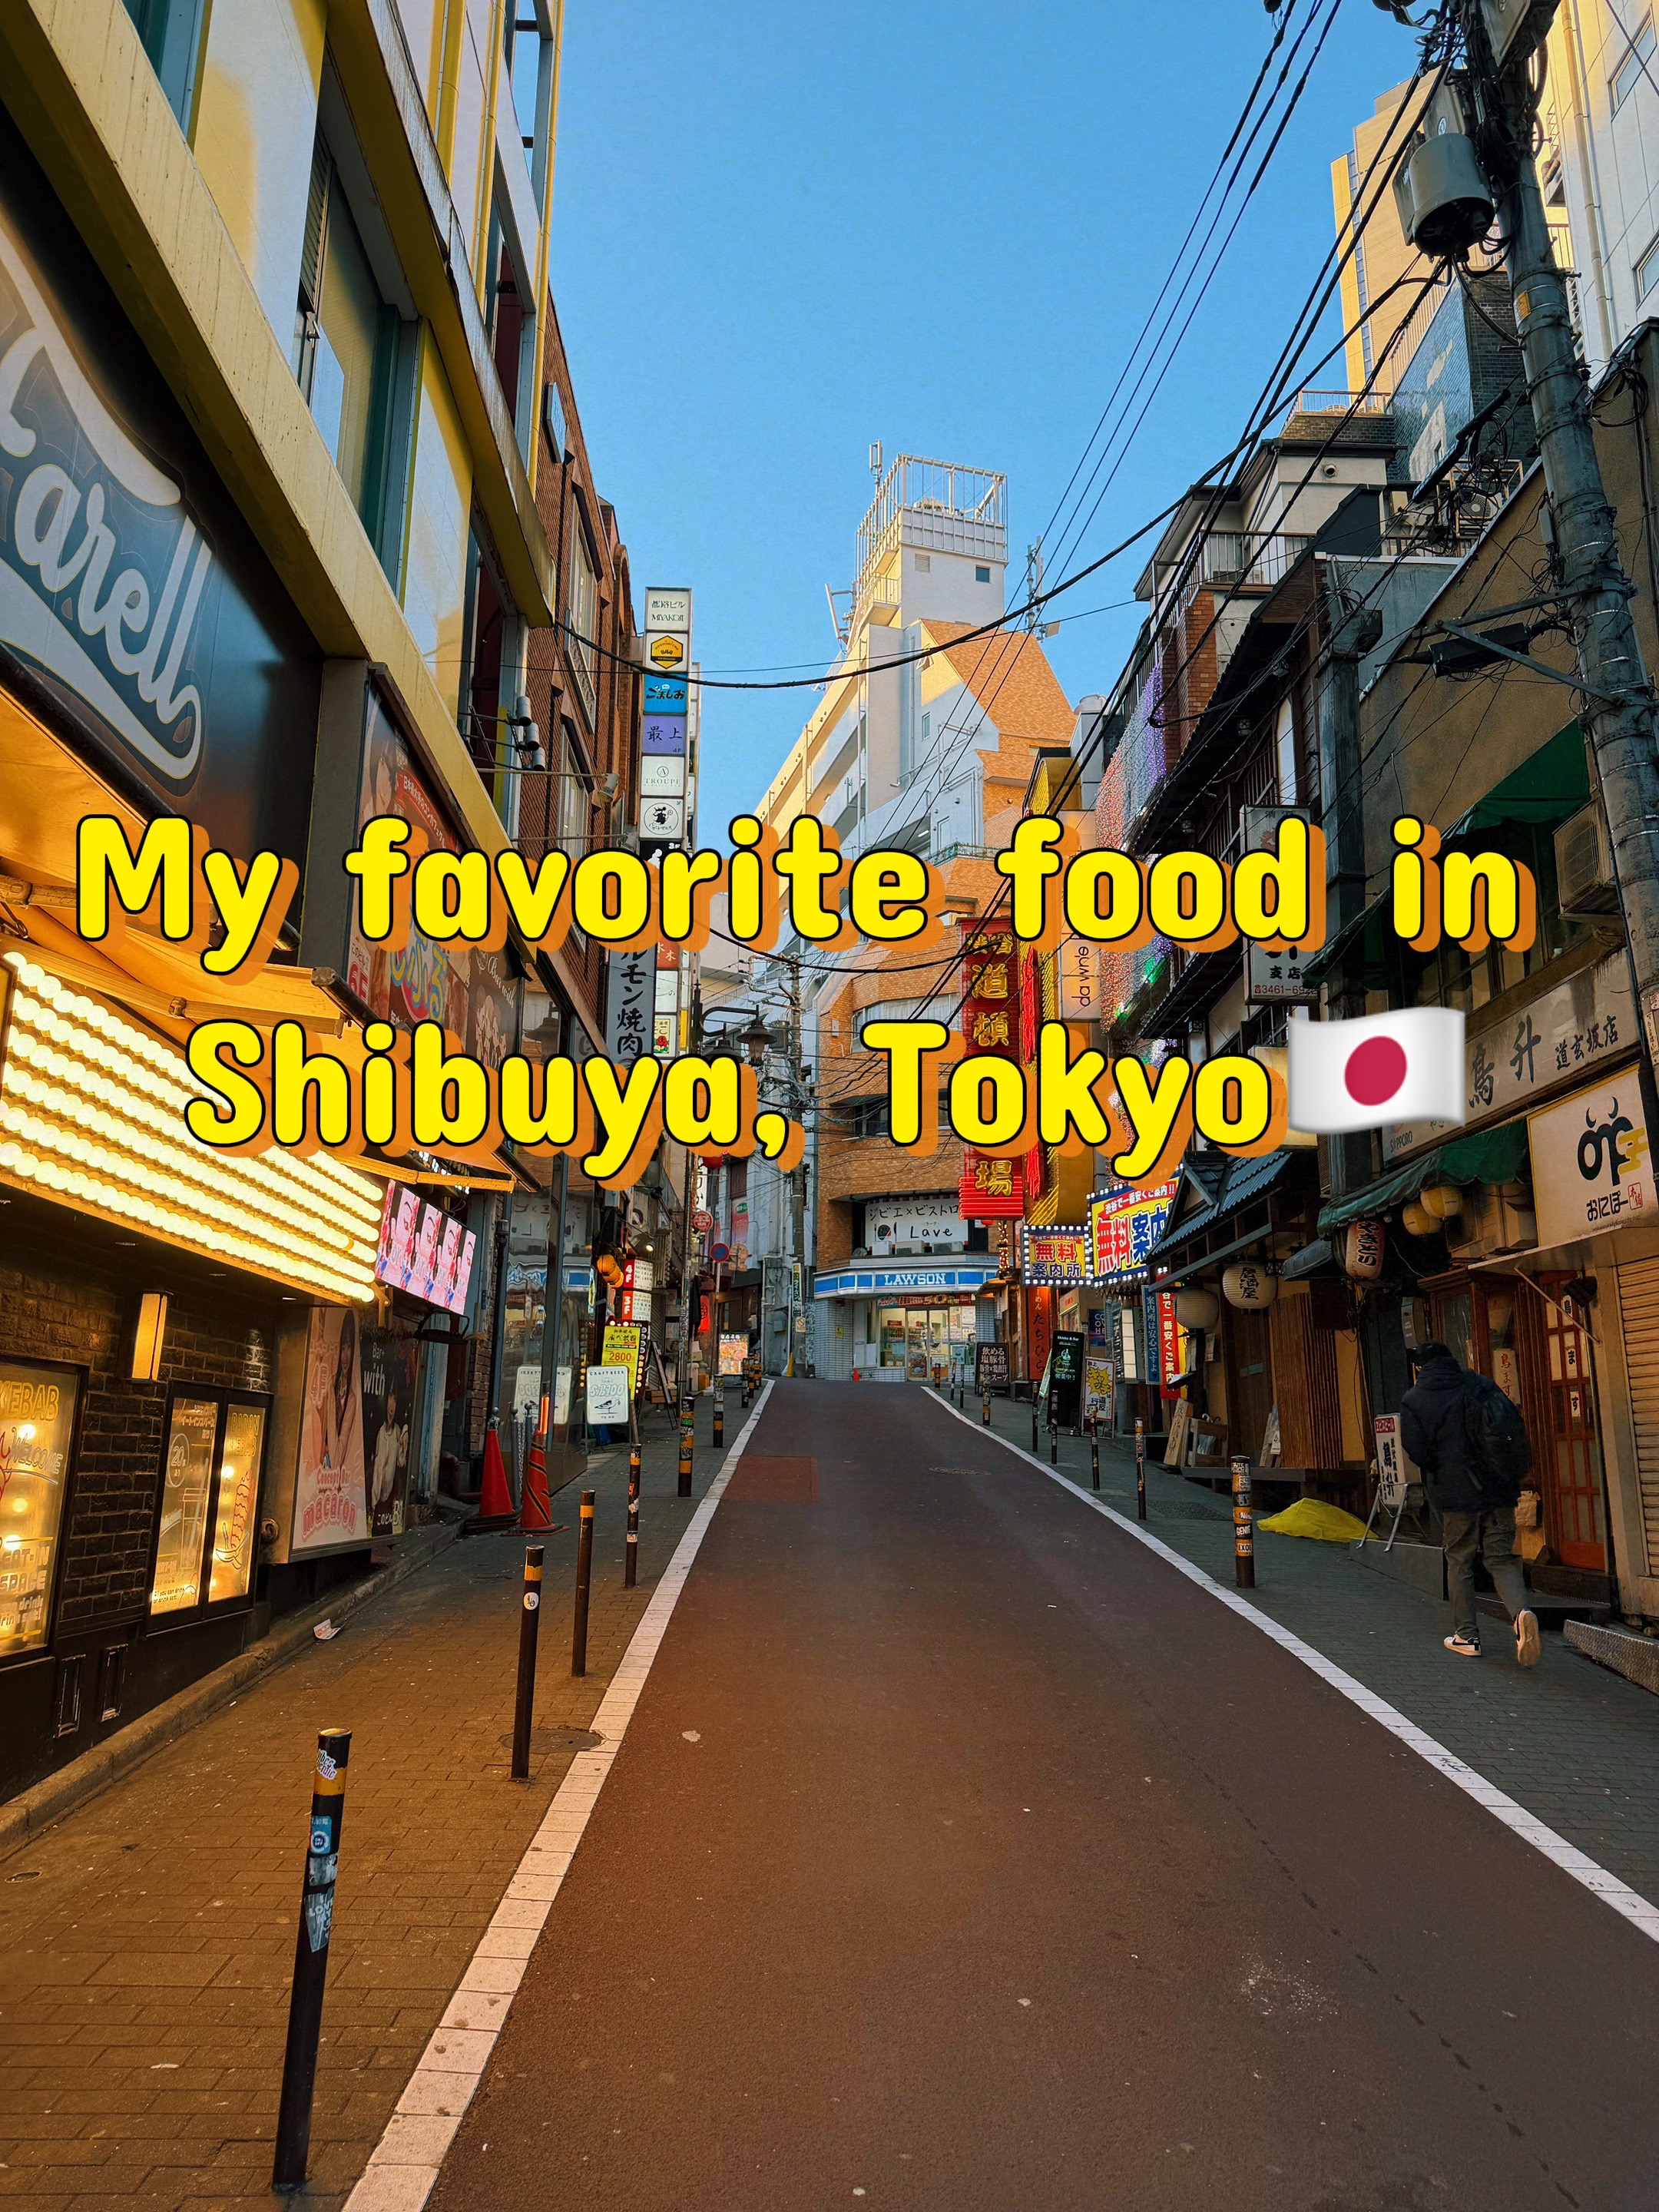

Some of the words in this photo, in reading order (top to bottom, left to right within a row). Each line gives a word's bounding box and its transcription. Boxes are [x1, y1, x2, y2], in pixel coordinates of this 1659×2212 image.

[647, 726, 682, 742] 最上
[617, 943, 647, 1058] ルモン焼肉
[1555, 1015, 1620, 1071] 道玄坂店
[1389, 1131, 1414, 1153] SAPPORO
[869, 1204, 959, 1221] ジビエ×ビストロ
[910, 1225, 953, 1239] Lave
[1035, 1241, 1077, 1262] 無料
[624, 1264, 633, 1283] 4F
[884, 1273, 946, 1286] LAWSON
[1031, 1262, 1081, 1277] 案内所
[1240, 1267, 1260, 1300] 居酒屋
[624, 1296, 631, 1314] 3F
[1034, 1288, 1042, 1310] ーめん
[1033, 1313, 1045, 1373] たちひら
[1162, 1293, 1174, 1382] 谷で一番安くご案内
[982, 1346, 1005, 1355] 飲める
[363, 1366, 386, 1396] with
[11, 1426, 64, 1474] WELCOME
[316, 1467, 339, 1489] Concept
[301, 1488, 358, 1543] macaron
